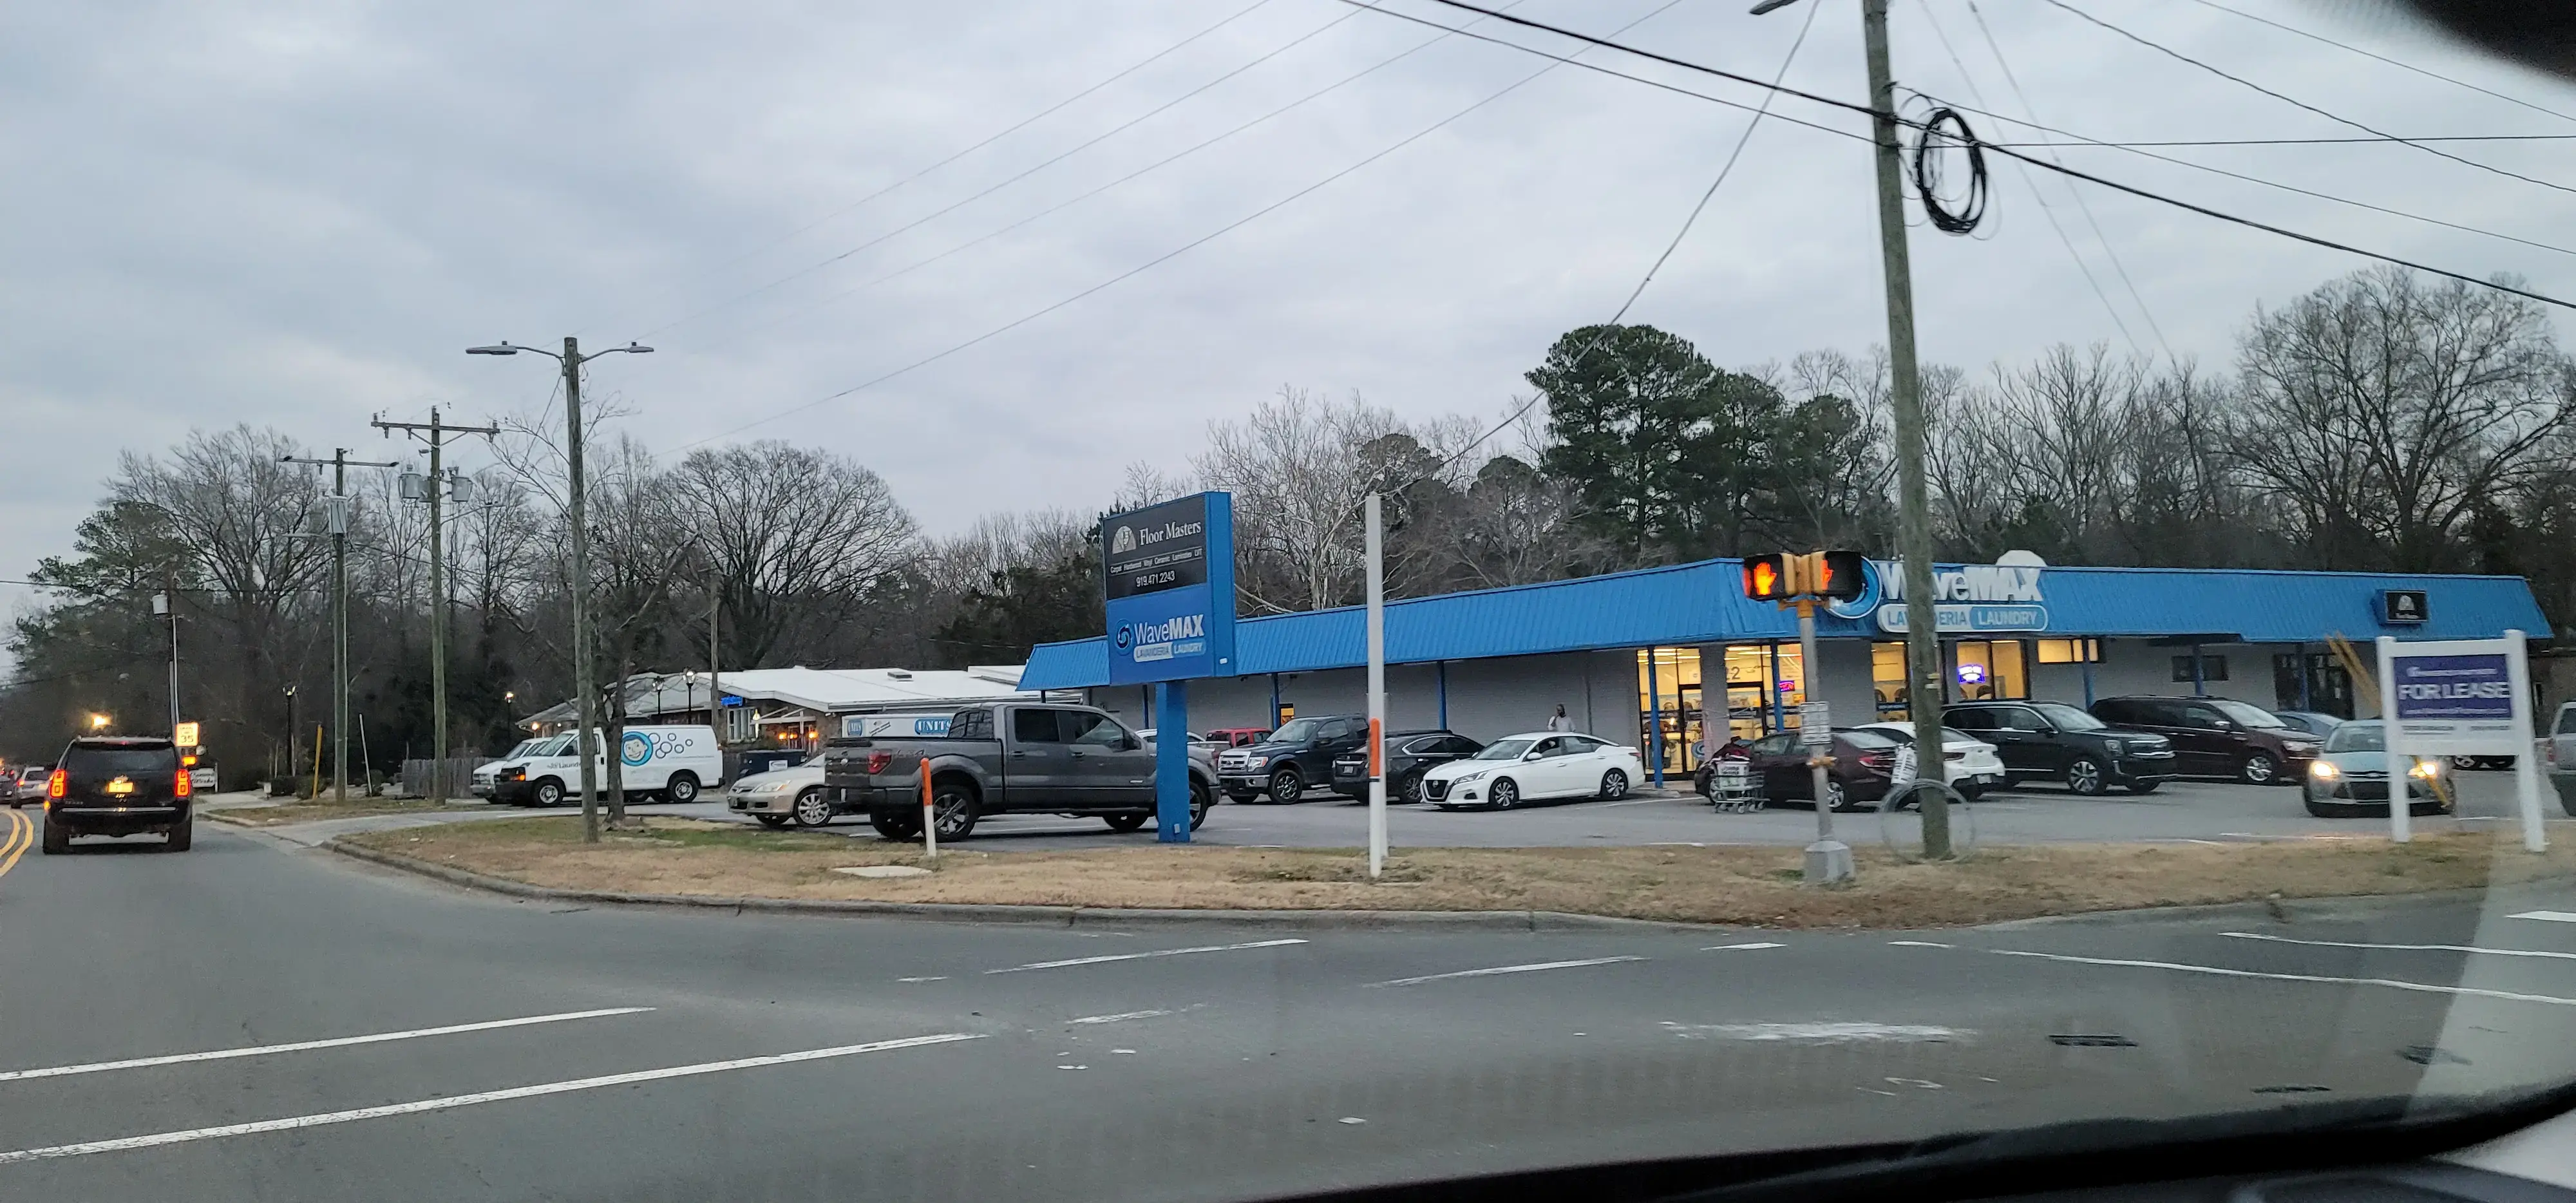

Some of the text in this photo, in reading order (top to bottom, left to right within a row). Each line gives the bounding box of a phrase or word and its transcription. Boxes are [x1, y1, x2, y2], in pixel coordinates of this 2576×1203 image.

[1140, 522, 1202, 545] Floor Masters
[1136, 571, 1175, 587] 919.471.2243
[1878, 563, 2043, 601] WveMAX
[1888, 611, 2038, 625] LAERIA LAUNDRY
[1134, 614, 1205, 645] WaveMAX
[1173, 643, 1203, 654] LAUNDRY
[2398, 681, 2512, 700] FOR LEASE
